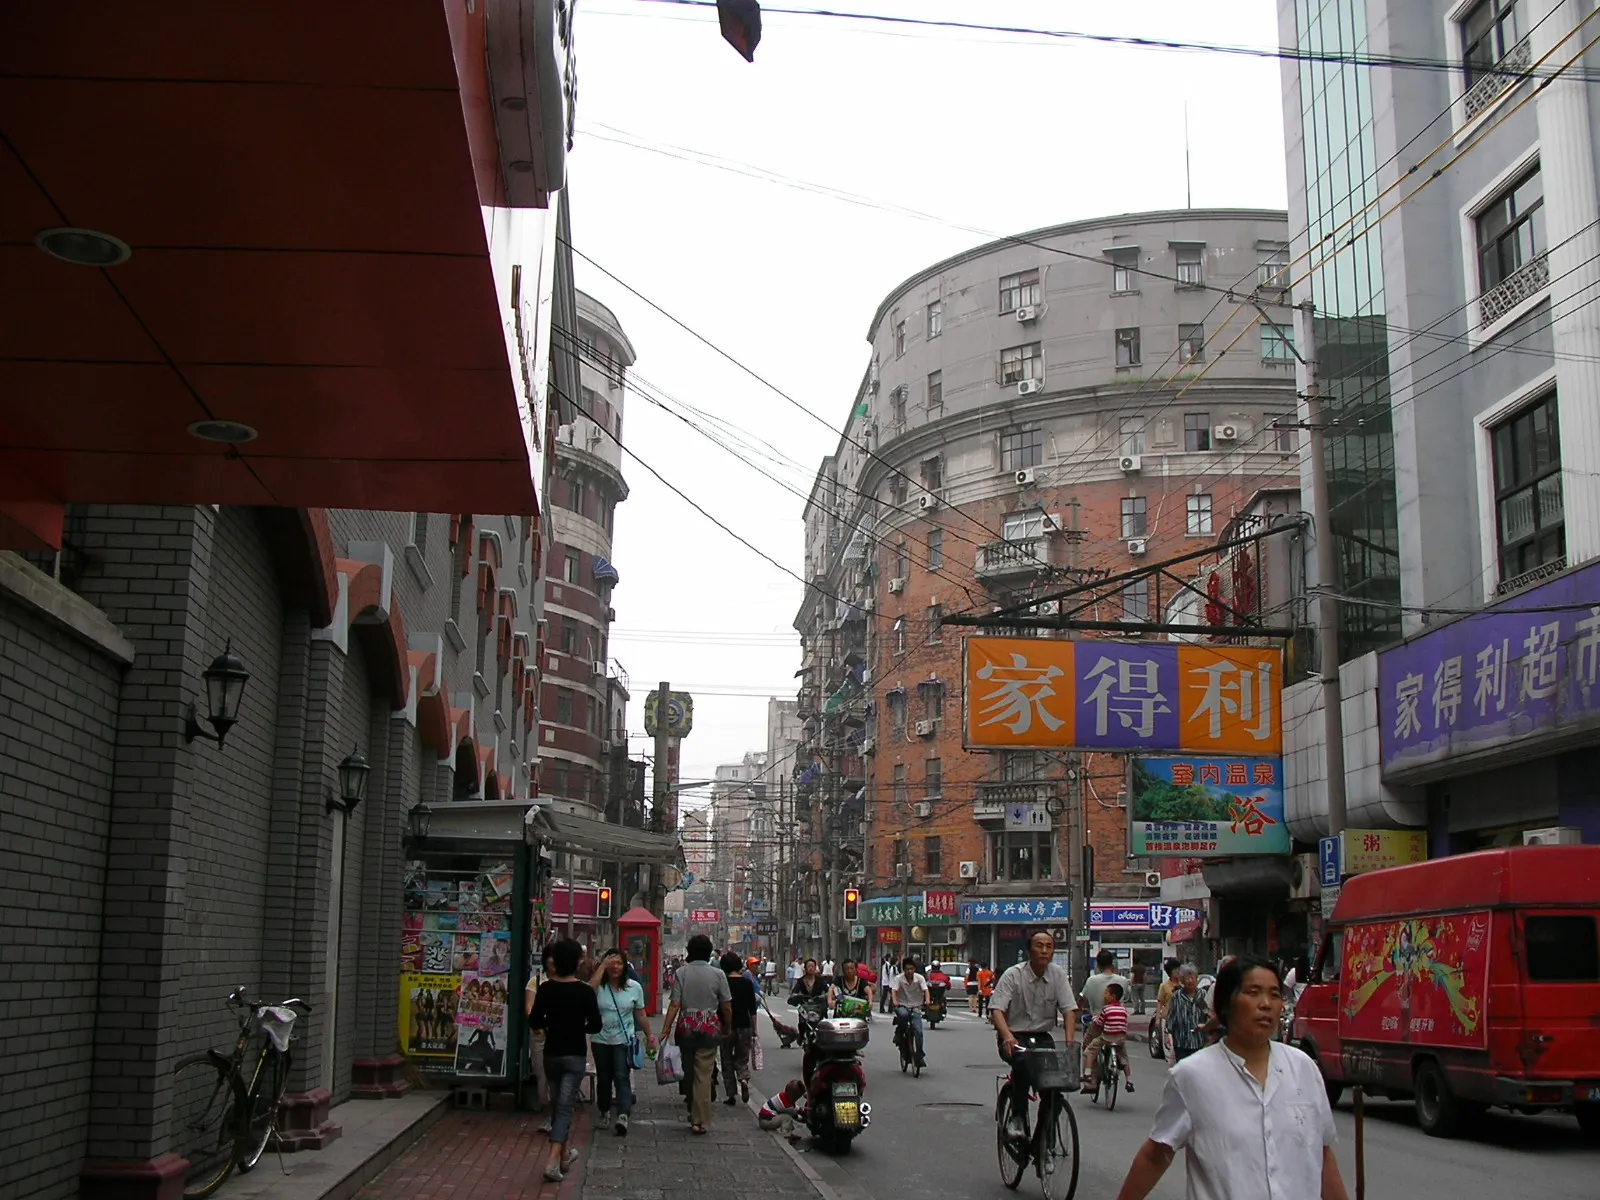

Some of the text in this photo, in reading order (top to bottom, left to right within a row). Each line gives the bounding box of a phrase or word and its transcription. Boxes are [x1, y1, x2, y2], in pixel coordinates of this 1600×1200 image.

[1394, 606, 1600, 740] 家得利超市
[976, 653, 1272, 741] 家得利
[1171, 762, 1276, 786] 室内温泉
[1229, 796, 1276, 836] 浴
[1325, 840, 1333, 861] P
[974, 901, 1063, 916] 虹房兴城房产
